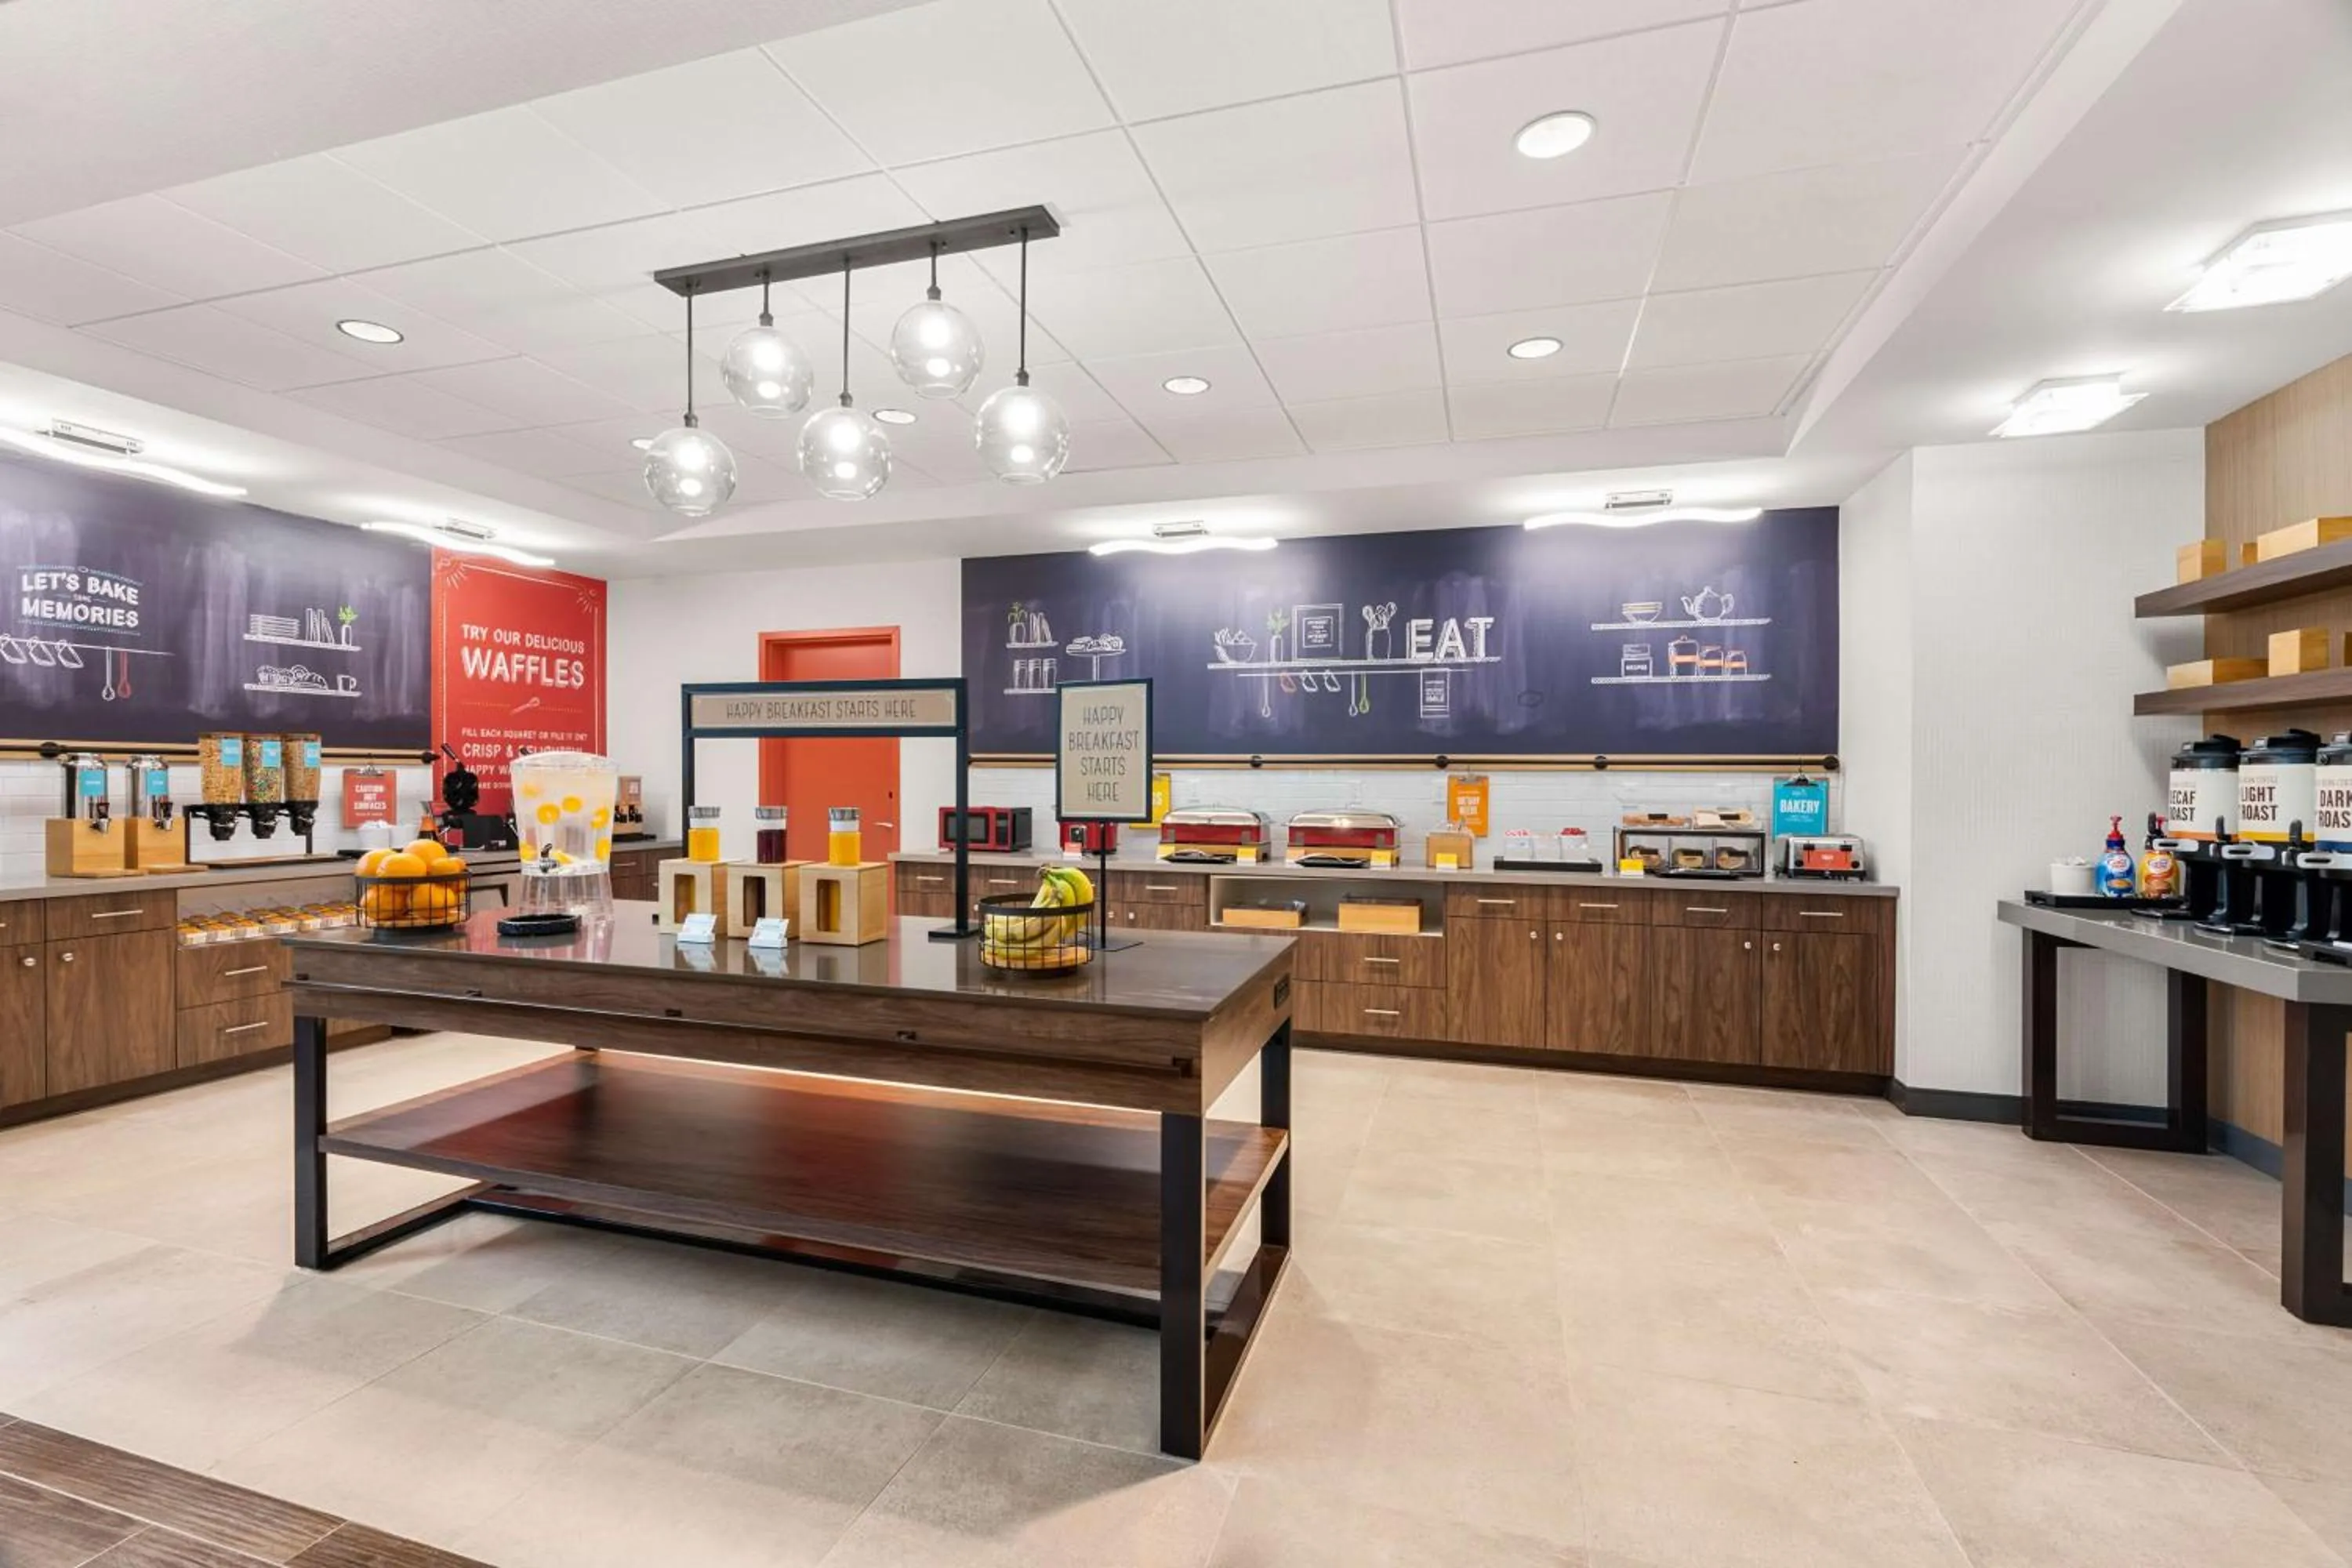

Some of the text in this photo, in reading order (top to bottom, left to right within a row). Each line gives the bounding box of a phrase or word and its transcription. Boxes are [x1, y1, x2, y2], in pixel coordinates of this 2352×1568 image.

[21, 572, 139, 605] LET'S BAKE
[21, 597, 139, 627] MEMORIES
[461, 623, 585, 655] TRY OUR DELICIOUS
[1406, 617, 1494, 662] EAT
[461, 645, 584, 690] WAFFLES
[727, 699, 916, 720] HAPPY BREAKFAST STARTS HERE
[1083, 706, 1123, 725] HAPPY
[481, 728, 501, 739] EACH
[1068, 731, 1138, 751] BREAKFAST
[462, 742, 501, 757] CRISP
[1080, 757, 1126, 775] STARTS
[1087, 782, 1119, 802] HERE
[2241, 786, 2276, 802] LIGHT
[1780, 799, 1820, 814] BAKERY
[2318, 810, 2351, 829] ROAS
